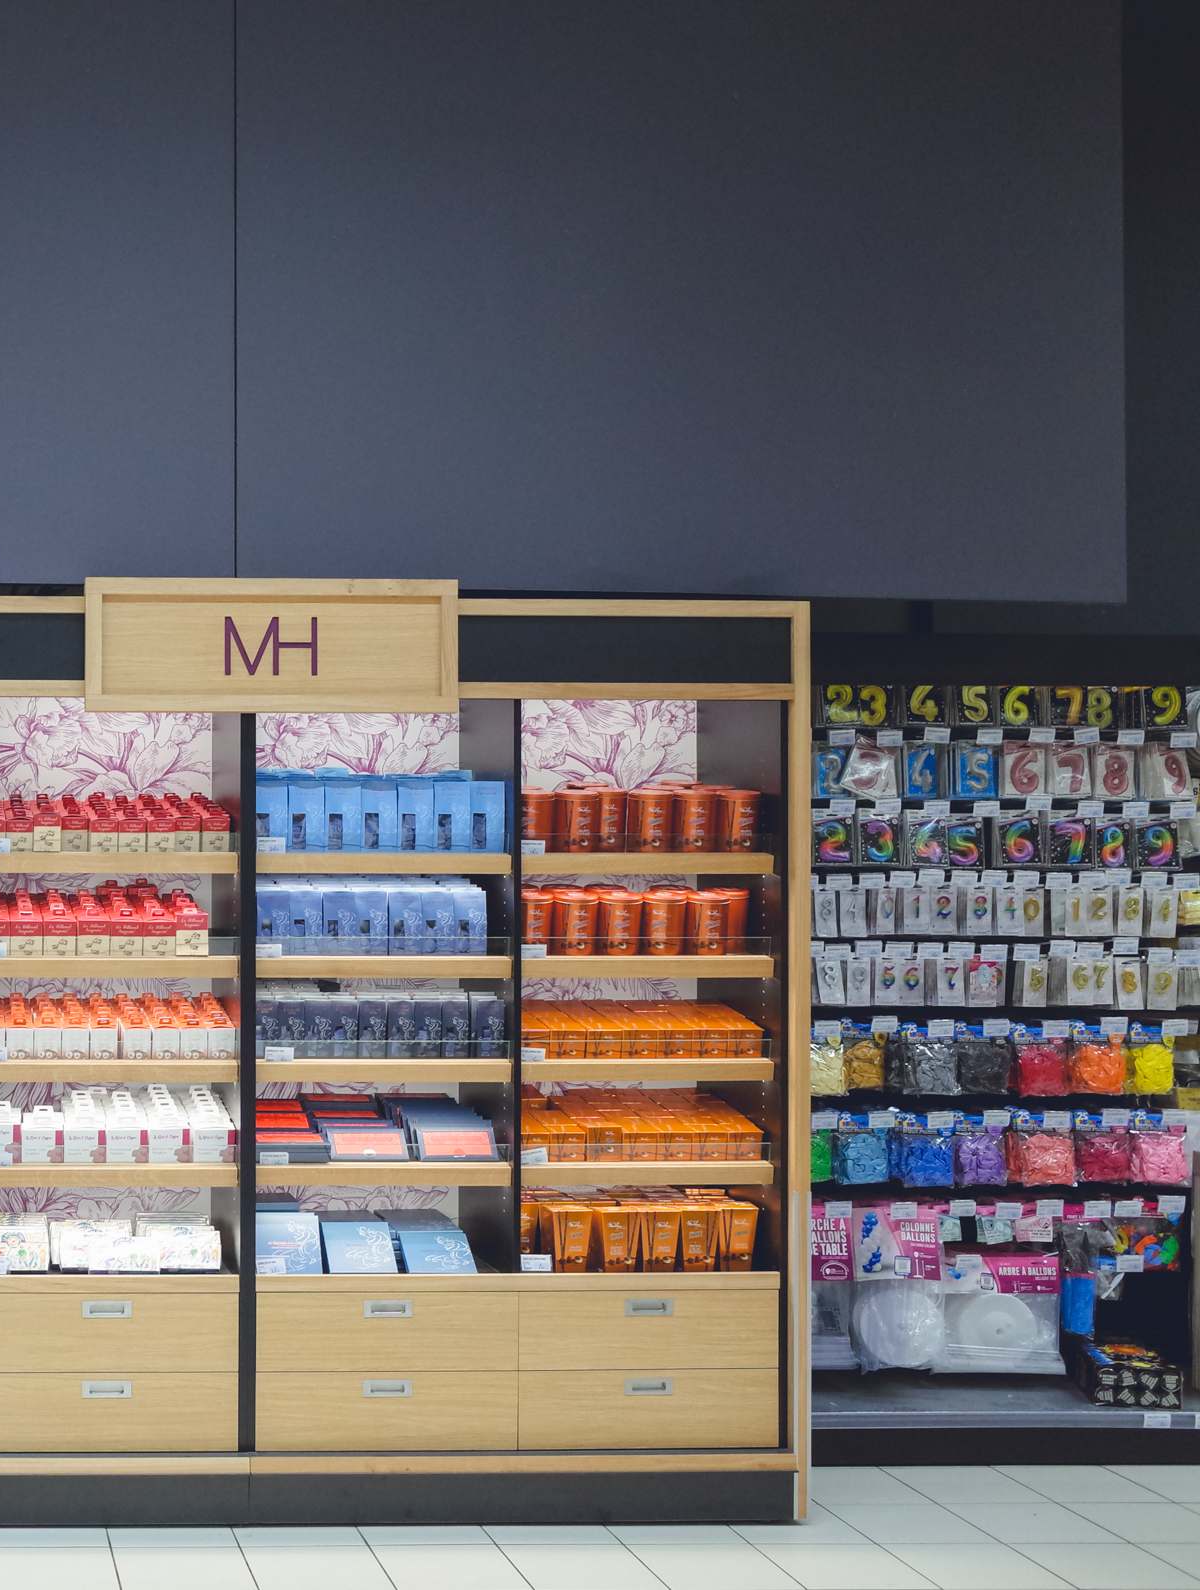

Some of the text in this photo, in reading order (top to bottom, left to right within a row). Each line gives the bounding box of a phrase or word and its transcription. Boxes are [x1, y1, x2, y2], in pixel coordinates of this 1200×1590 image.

[224, 616, 318, 676] MH
[900, 1222, 935, 1232] COLONNE
[901, 1232, 935, 1243] BALLONS
[819, 1244, 848, 1255] TABLE
[998, 1267, 1020, 1276] ARBRE
[1028, 1267, 1056, 1276] BALLONS
